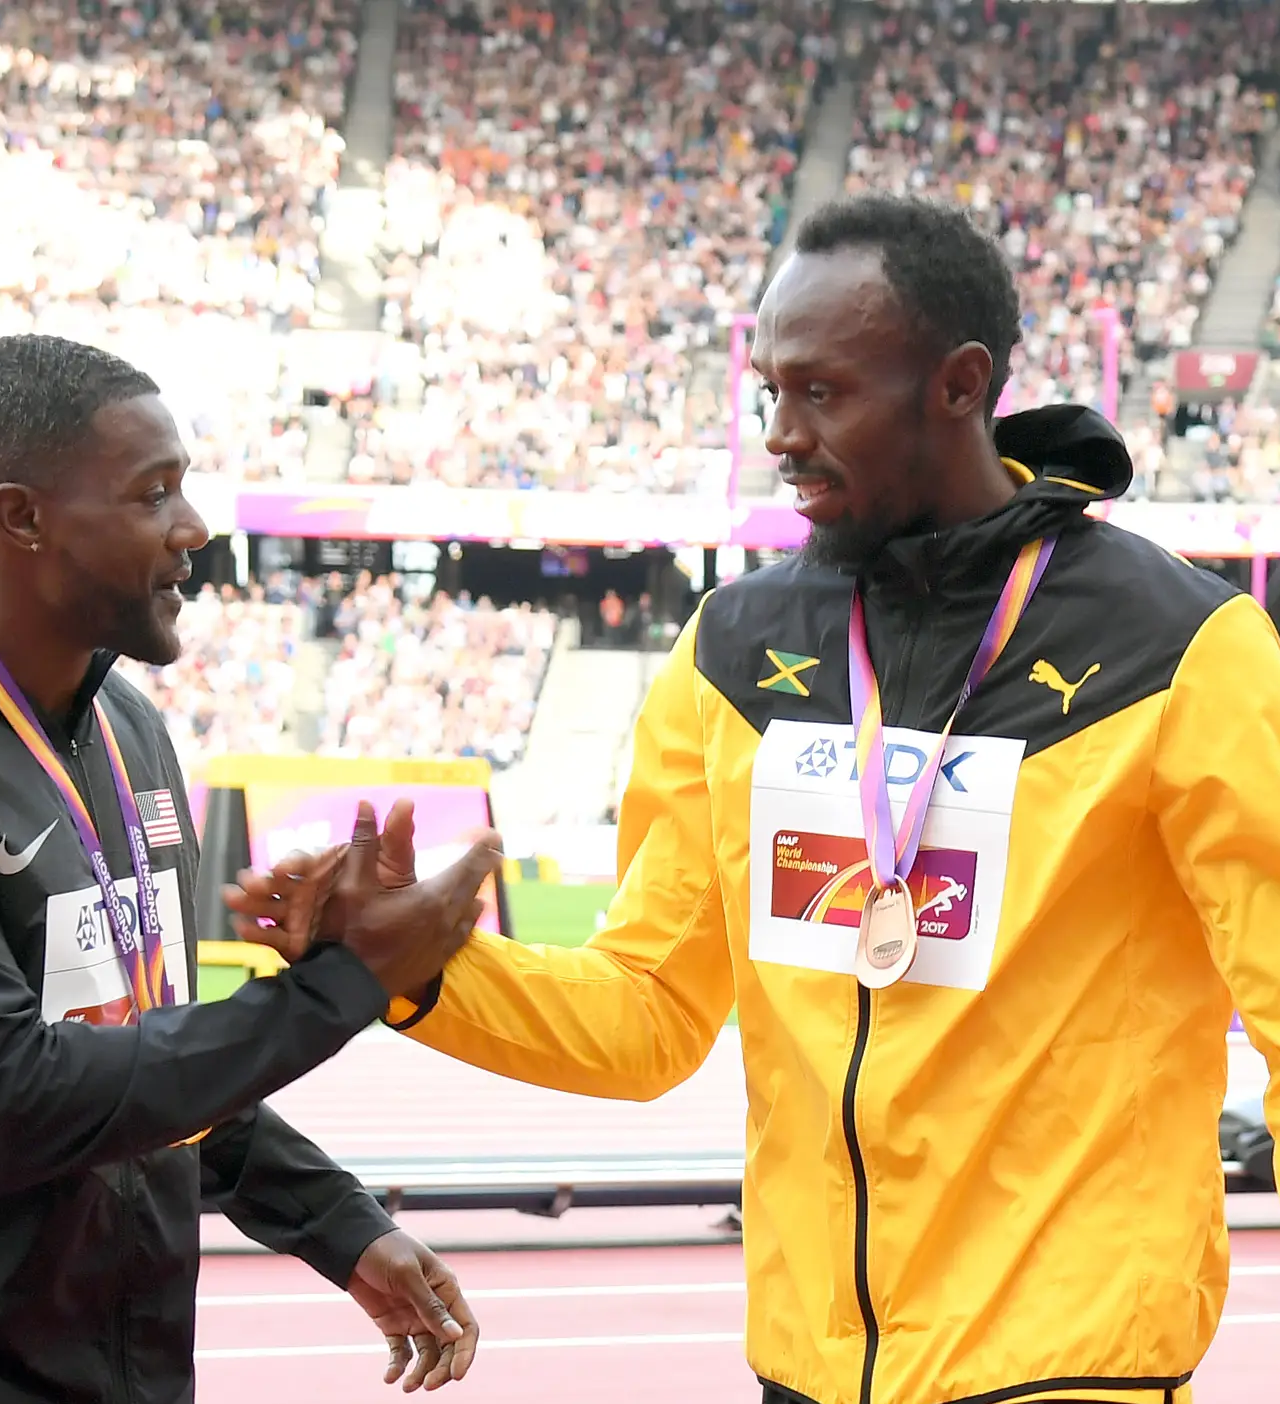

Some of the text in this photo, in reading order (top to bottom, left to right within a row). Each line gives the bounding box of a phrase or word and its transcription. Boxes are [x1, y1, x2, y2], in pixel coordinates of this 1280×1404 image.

[843, 741, 976, 792] TDK
[776, 835, 799, 846] IAAF
[776, 845, 802, 859] World
[776, 856, 838, 876] Championships
[133, 825, 159, 934] LONDON 2017
[93, 850, 135, 952] LONDON 2017
[921, 919, 949, 935] 2017
